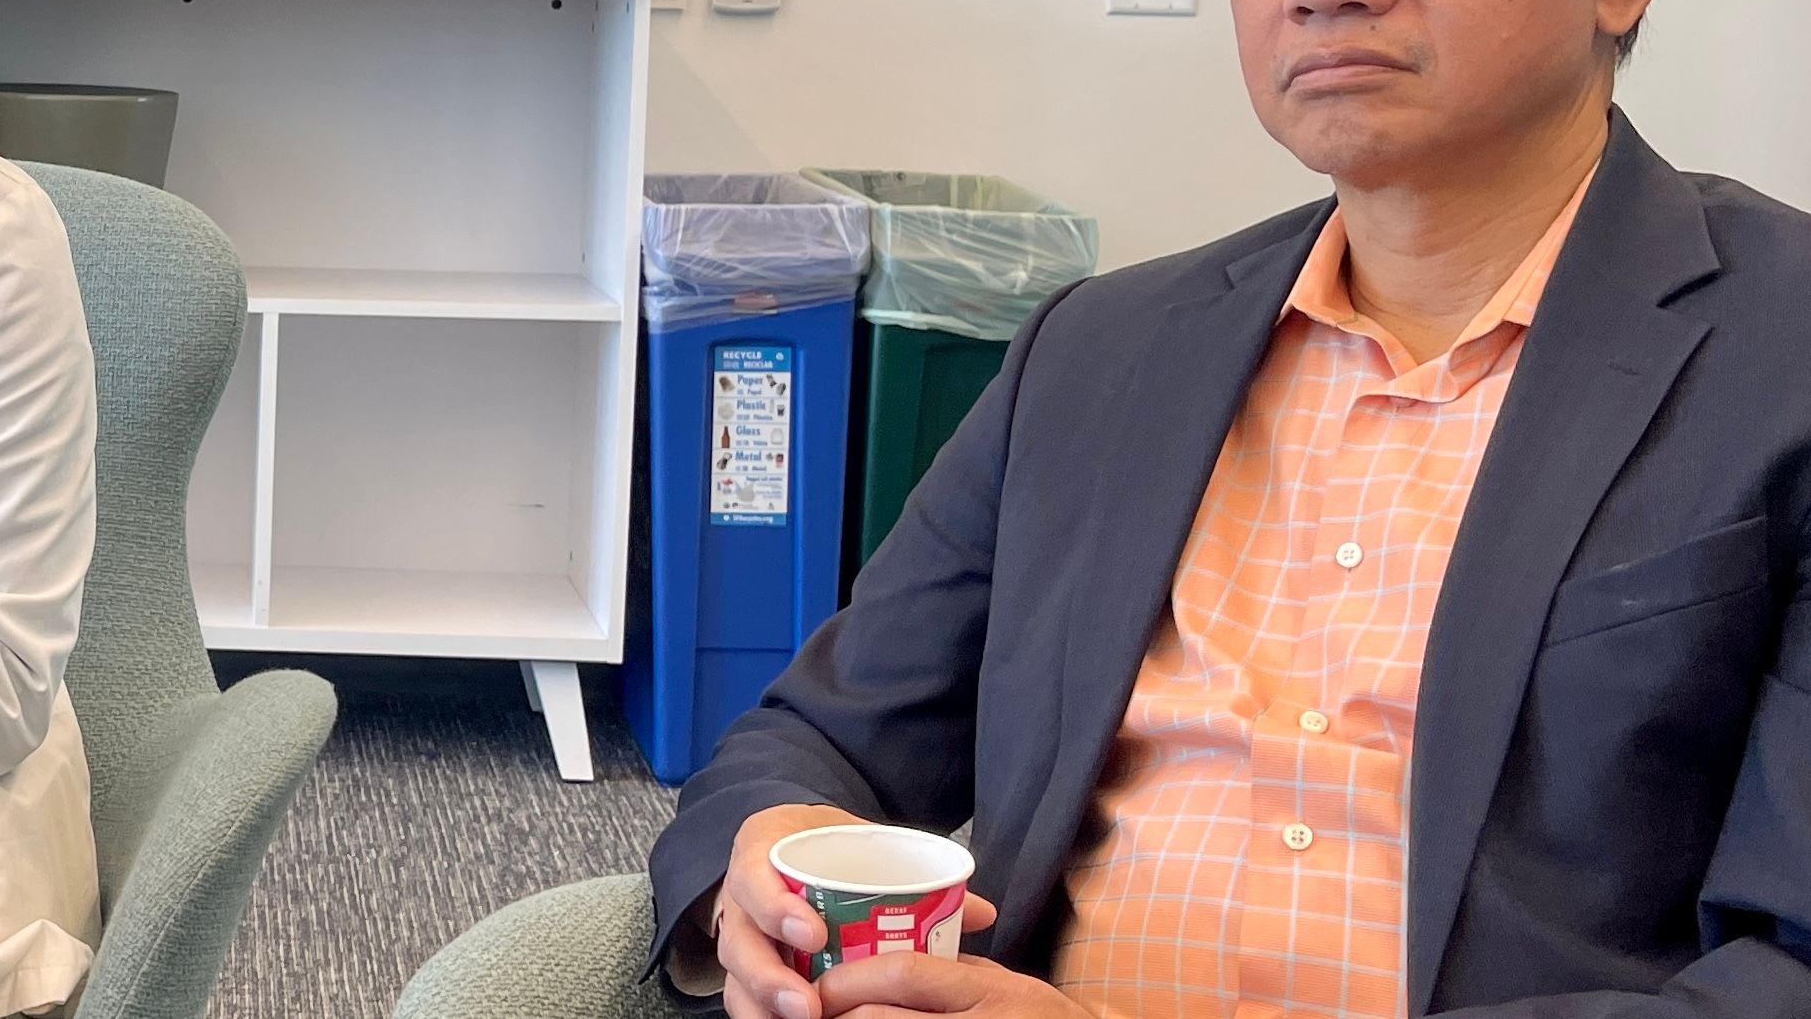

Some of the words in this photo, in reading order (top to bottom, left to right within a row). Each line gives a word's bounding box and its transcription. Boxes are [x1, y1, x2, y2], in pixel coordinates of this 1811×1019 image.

[723, 351, 762, 360] RECYCLE
[737, 374, 763, 387] Paper
[737, 398, 766, 410] Plastic
[735, 425, 761, 436] Glass
[735, 451, 762, 461] Metal
